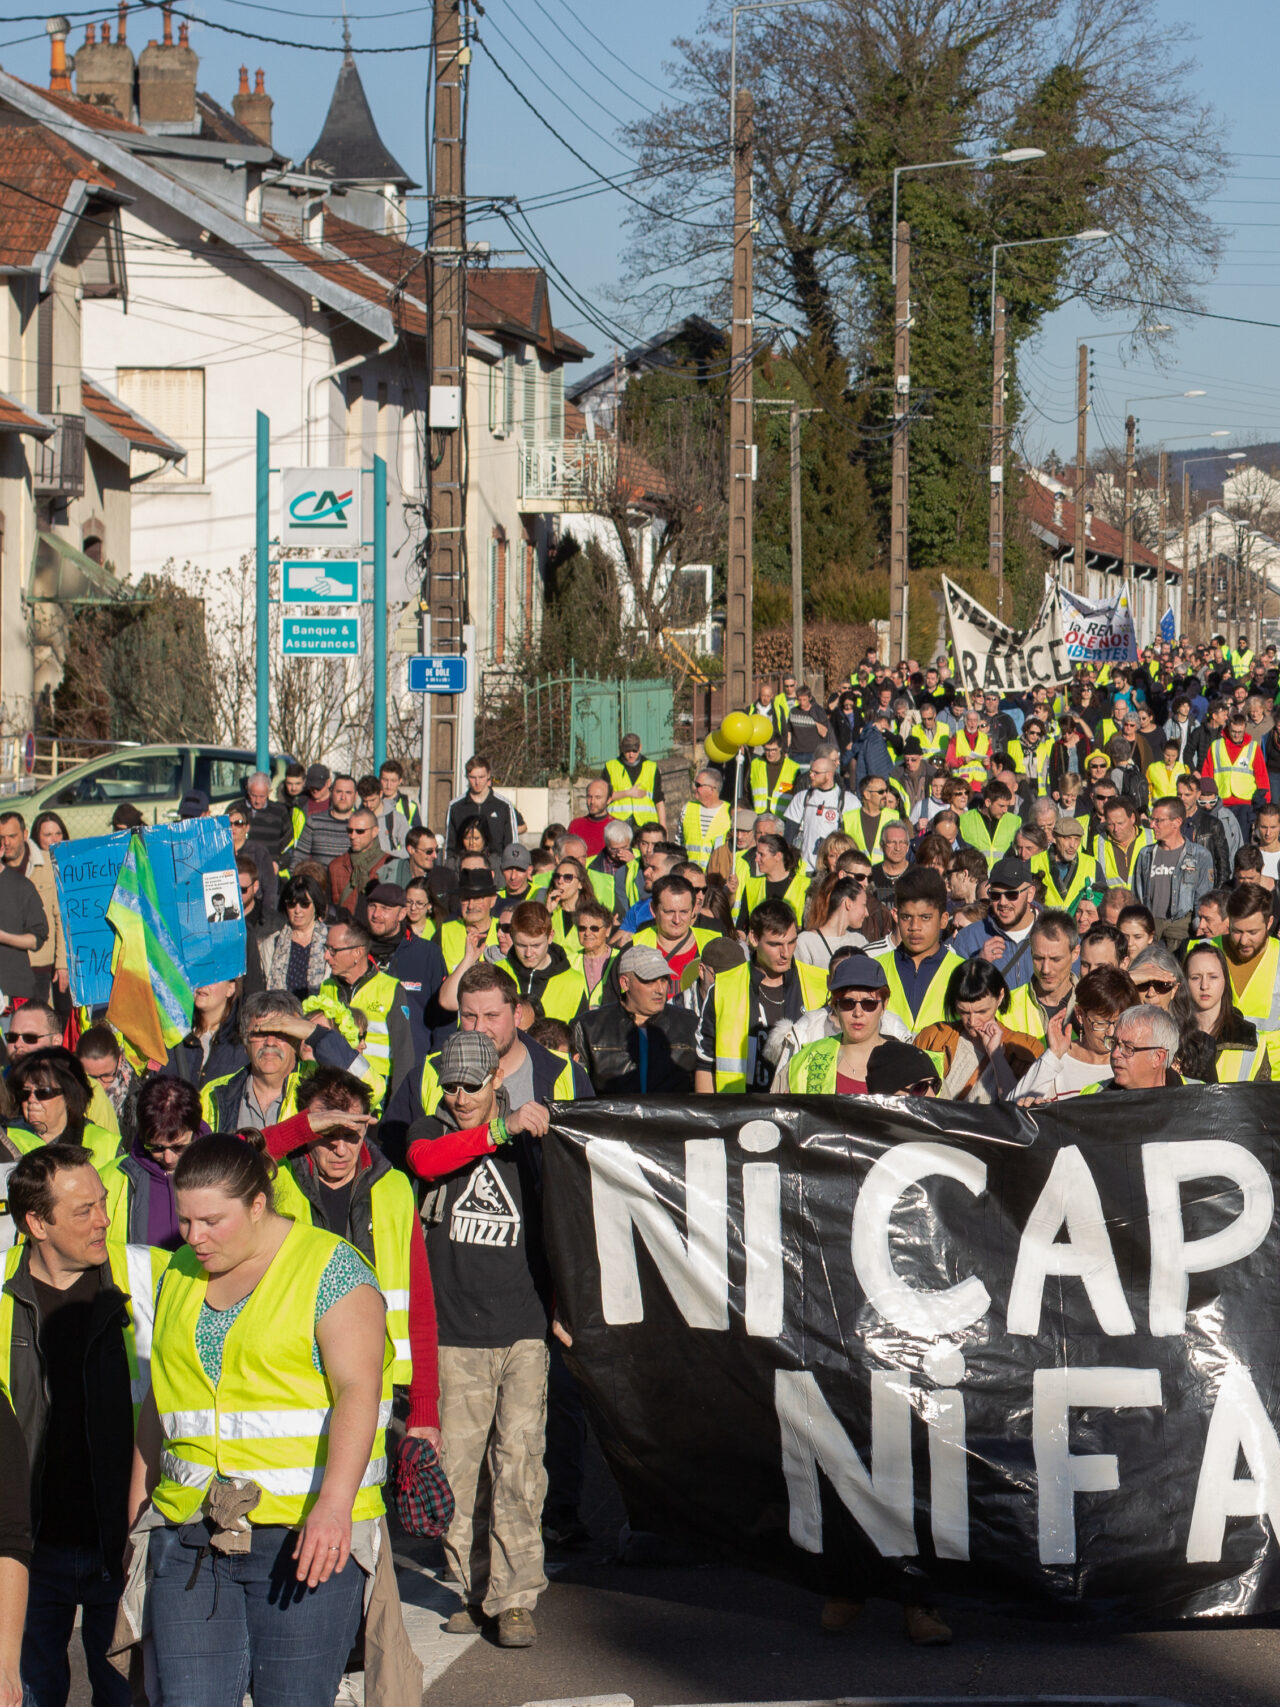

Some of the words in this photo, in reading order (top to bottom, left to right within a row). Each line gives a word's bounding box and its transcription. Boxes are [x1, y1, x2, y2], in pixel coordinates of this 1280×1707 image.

[292, 625, 337, 636] Banque
[341, 625, 350, 635] &
[285, 639, 356, 649] Assurances
[450, 1216, 508, 1247] WIZZZ
[510, 1222, 521, 1247] !
